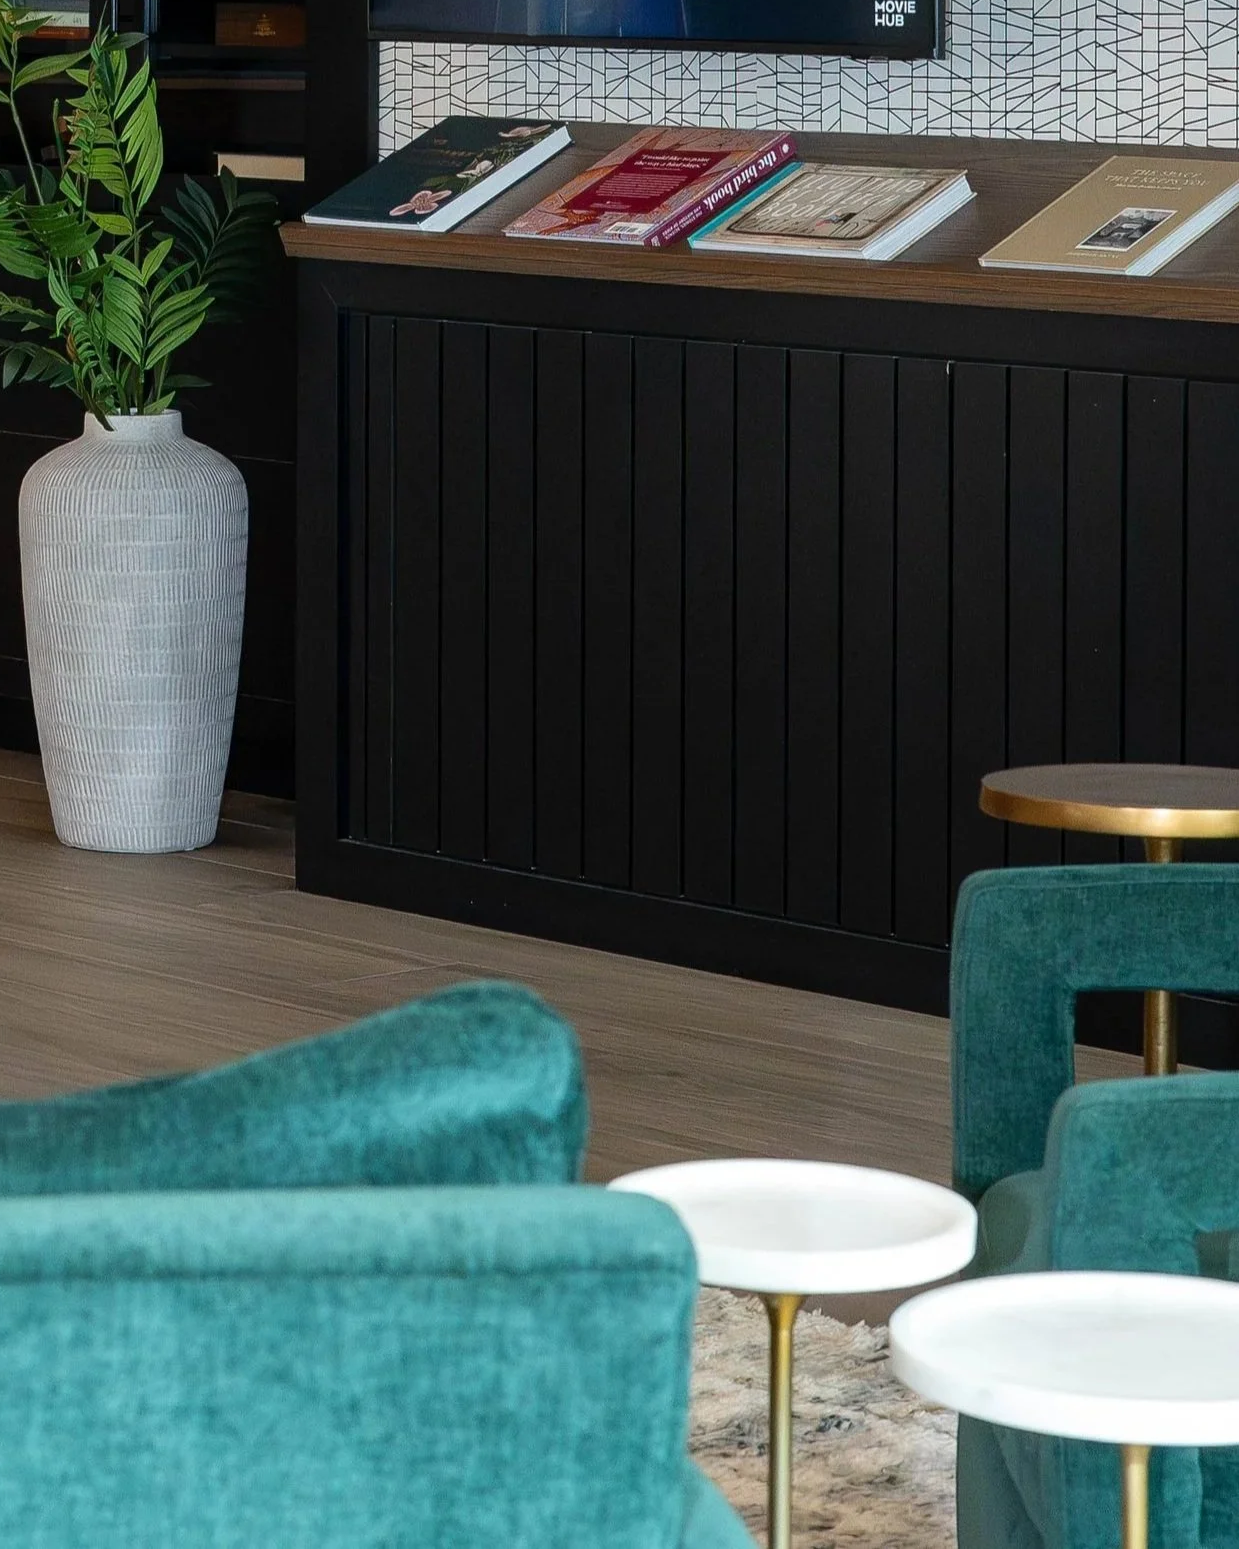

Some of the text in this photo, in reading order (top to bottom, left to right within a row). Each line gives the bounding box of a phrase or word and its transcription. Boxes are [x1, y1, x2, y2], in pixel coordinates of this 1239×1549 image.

[874, 0, 916, 14] MOVIE
[874, 14, 904, 27] HUB
[757, 151, 776, 170] the
[732, 164, 758, 192] bird
[702, 182, 734, 210] book
